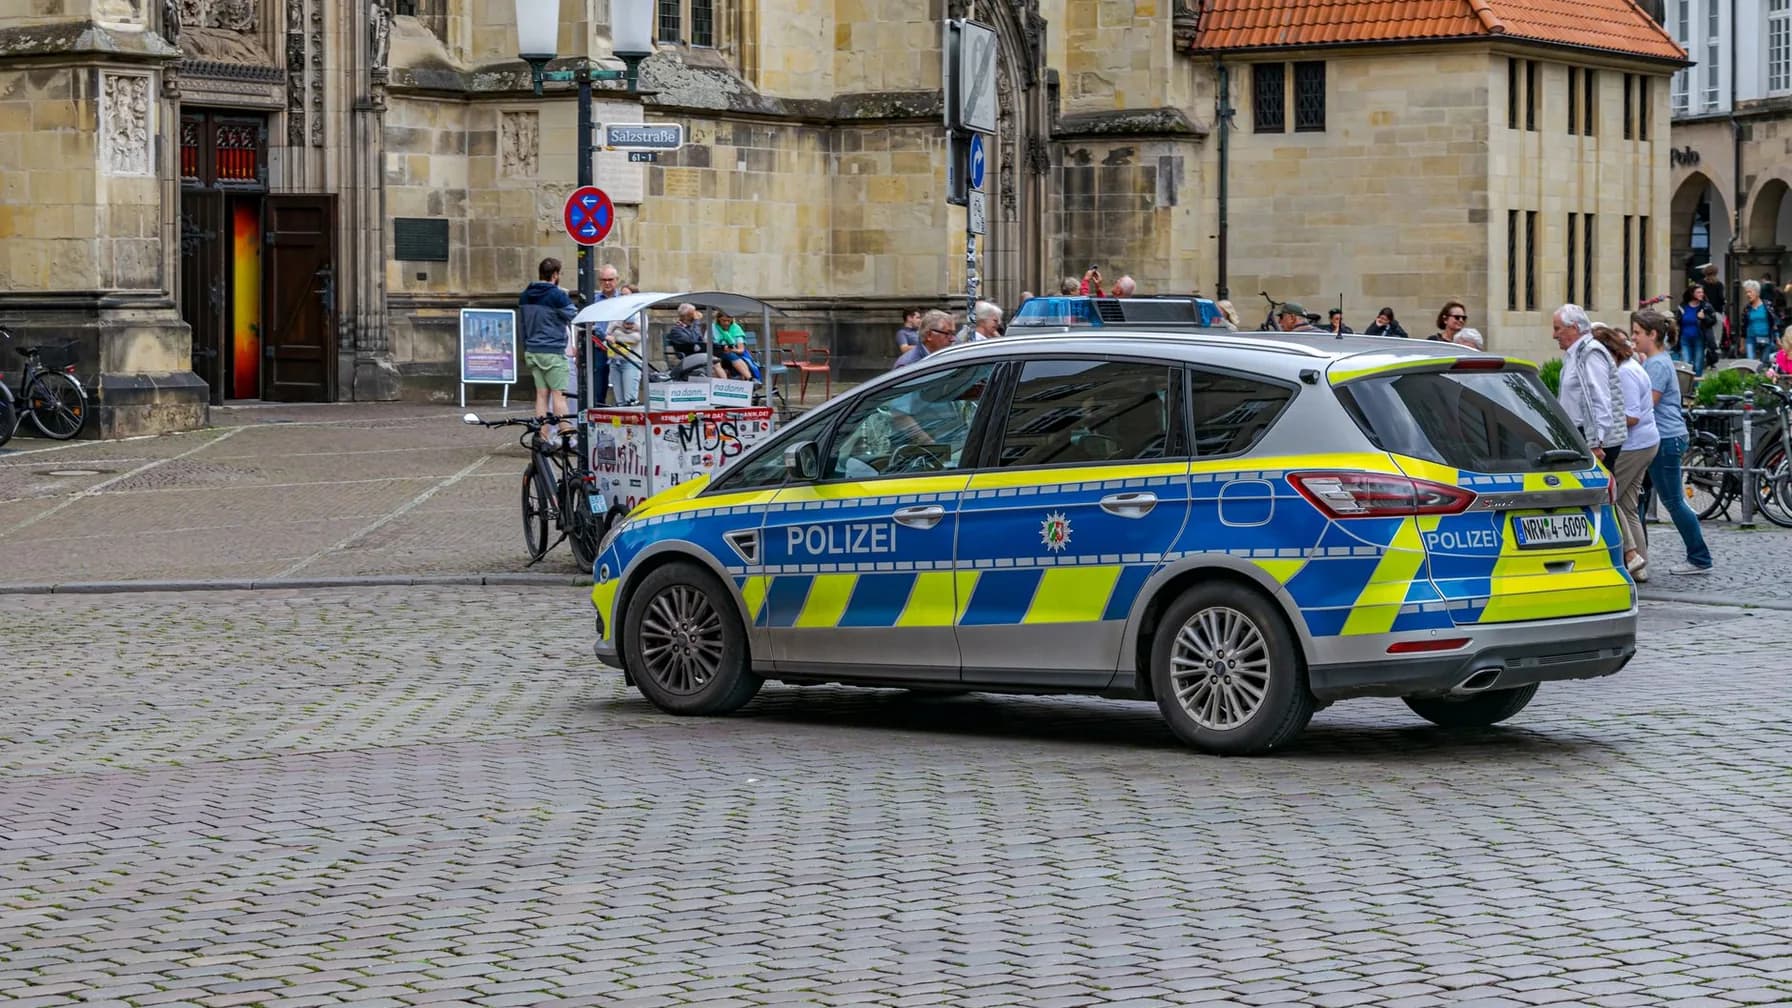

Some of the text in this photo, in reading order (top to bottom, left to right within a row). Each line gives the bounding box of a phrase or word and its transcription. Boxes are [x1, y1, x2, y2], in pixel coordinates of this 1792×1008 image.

[611, 130, 675, 143] Salzstraße
[1522, 515, 1588, 540] NRW 4-6099
[787, 523, 896, 555] POLIZEI
[1427, 530, 1498, 550] POLIZEI
